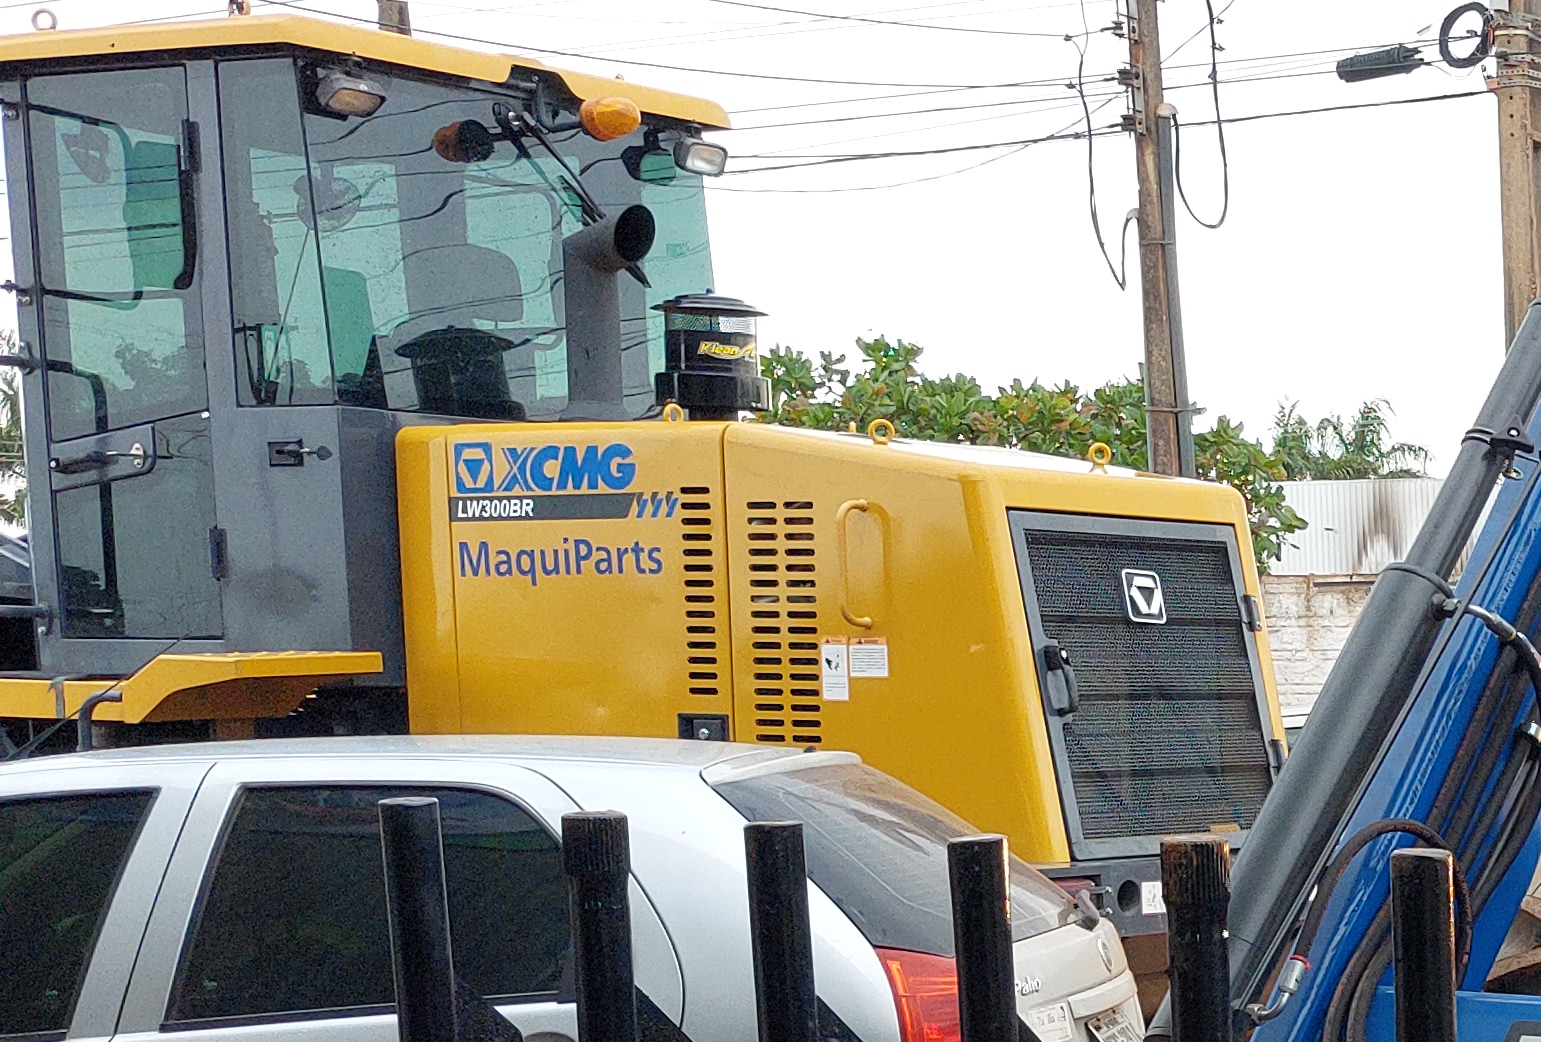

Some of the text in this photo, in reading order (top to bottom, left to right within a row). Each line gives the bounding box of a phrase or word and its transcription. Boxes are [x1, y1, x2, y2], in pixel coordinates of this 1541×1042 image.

[497, 443, 637, 492] XCMG
[457, 499, 534, 518] LW300BR
[459, 538, 663, 587] MaquiParts
